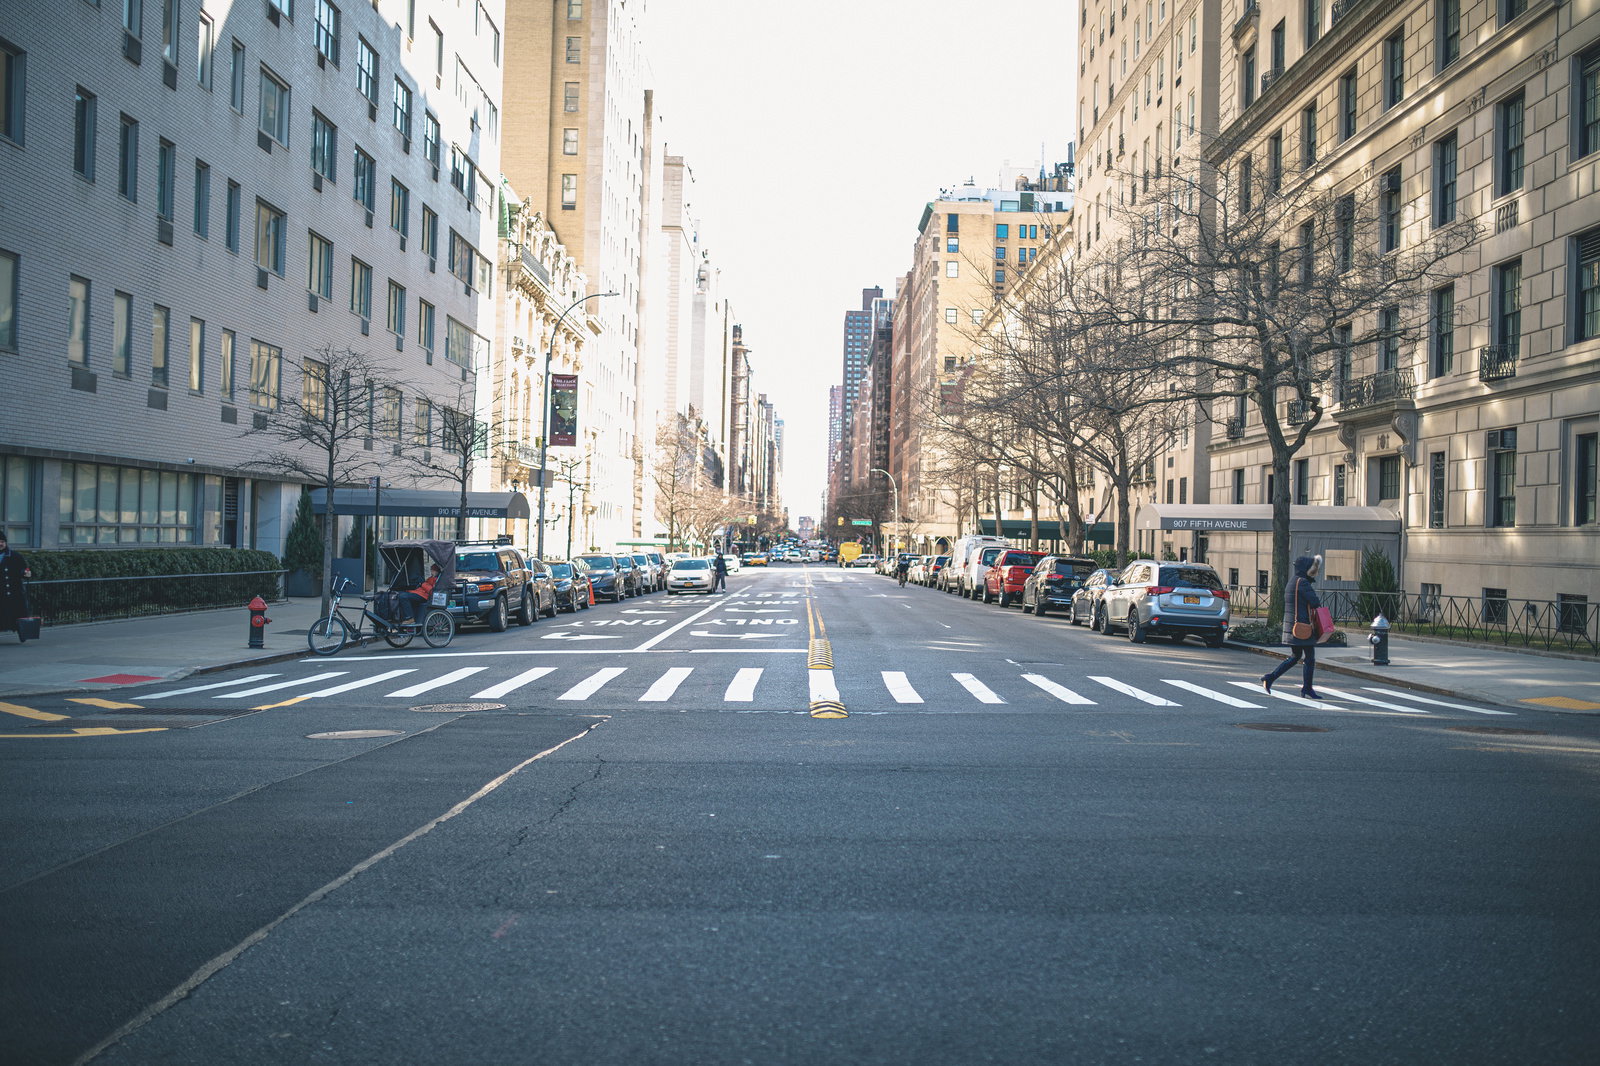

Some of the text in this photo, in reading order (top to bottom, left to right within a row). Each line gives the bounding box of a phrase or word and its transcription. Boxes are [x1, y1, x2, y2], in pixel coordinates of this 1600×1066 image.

[451, 508, 470, 516] FIFH
[1173, 519, 1248, 529] 907 FIFTH AVENUE
